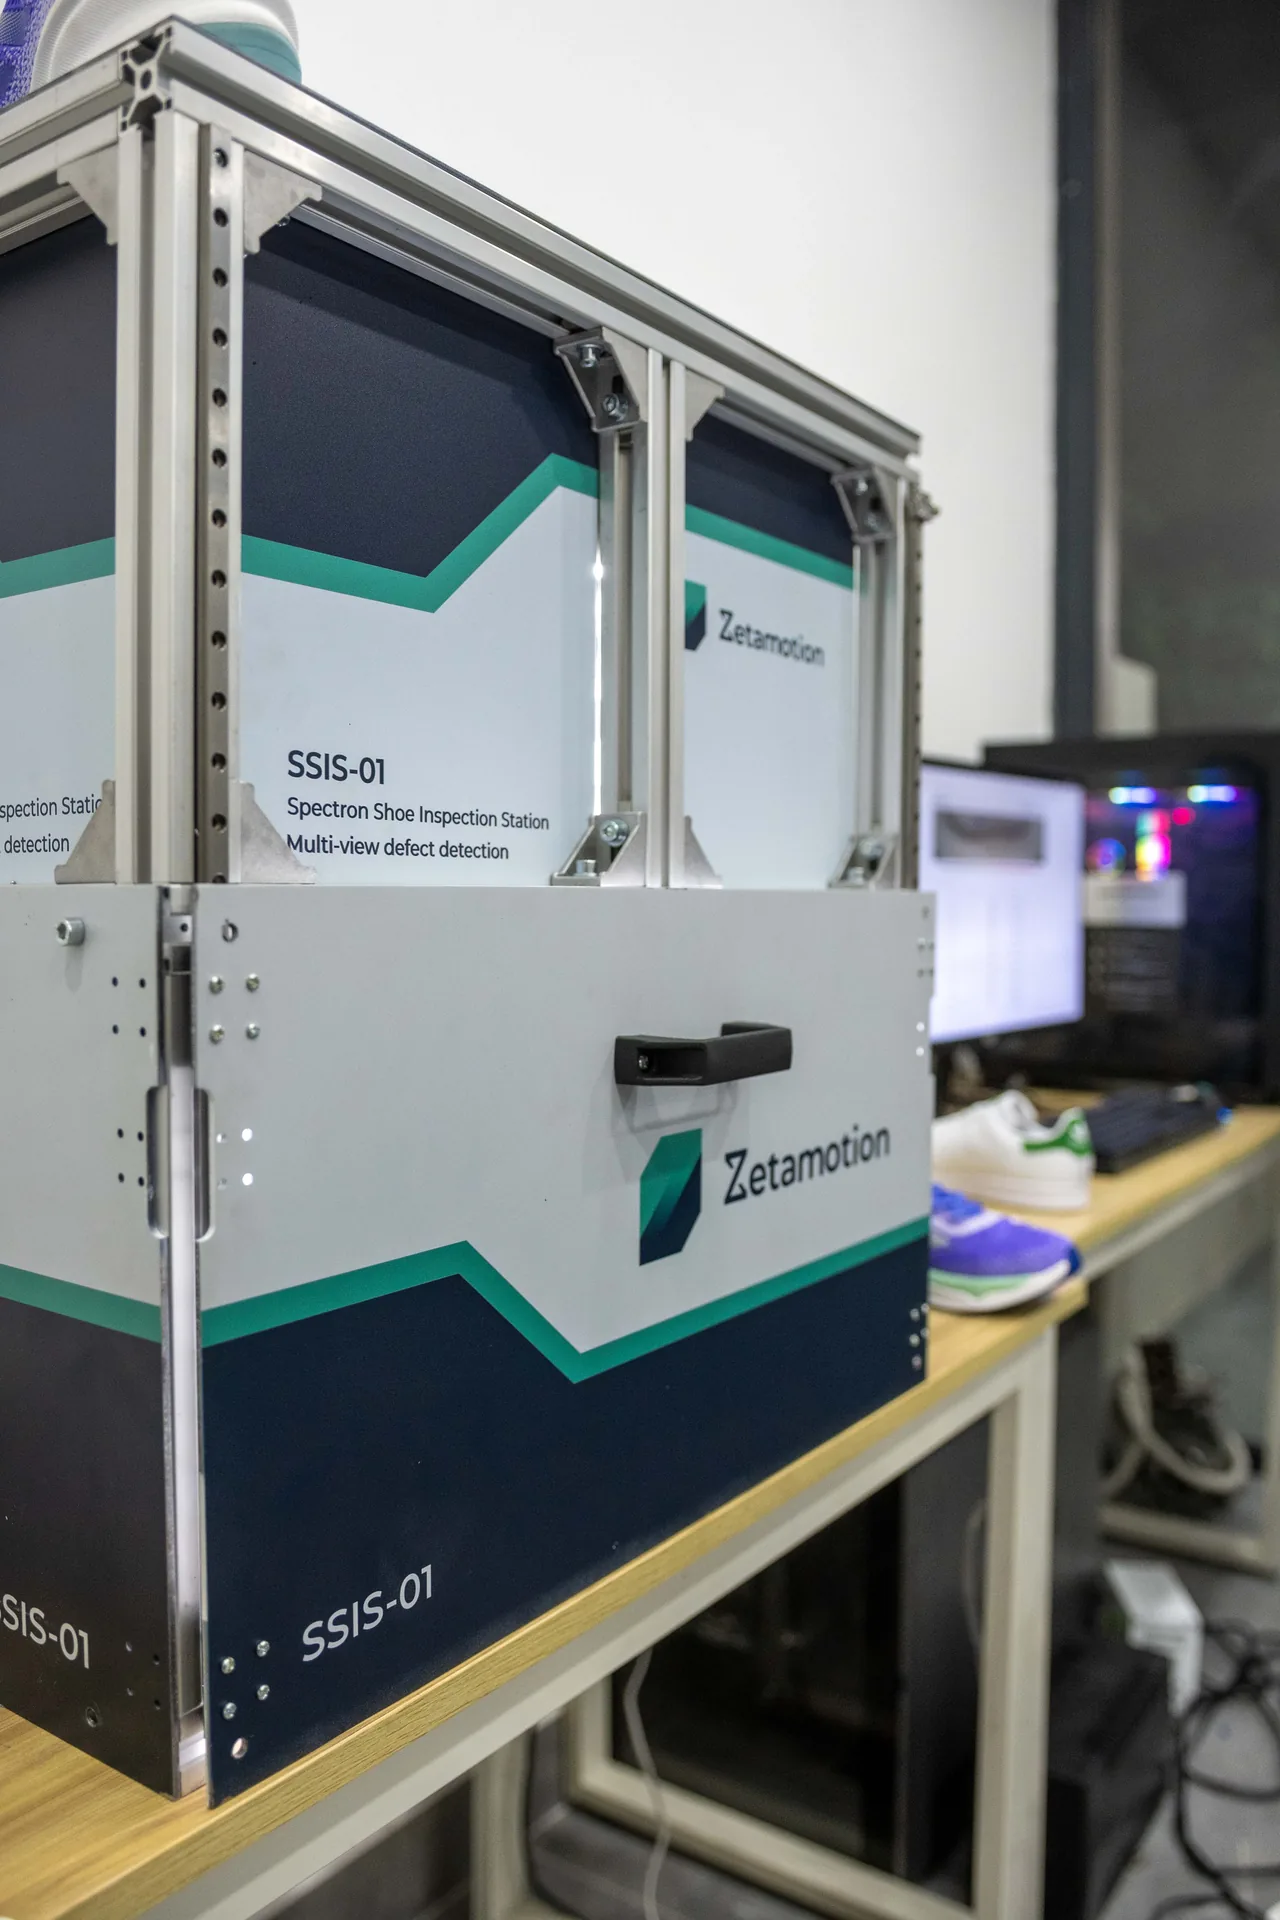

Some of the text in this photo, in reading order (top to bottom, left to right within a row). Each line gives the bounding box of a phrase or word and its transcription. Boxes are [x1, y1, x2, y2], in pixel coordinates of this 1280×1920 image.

[719, 608, 826, 668] Zetamotion
[287, 749, 385, 785] SSIS-01
[287, 796, 550, 830] Spectron Shoe Inspection Station
[3, 833, 70, 854] detection
[286, 833, 509, 860] Multi-view defect detection
[724, 1123, 891, 1206] Zetamotion
[0, 1593, 89, 1669] SIS-01
[302, 1563, 433, 1662] SSIS-01
